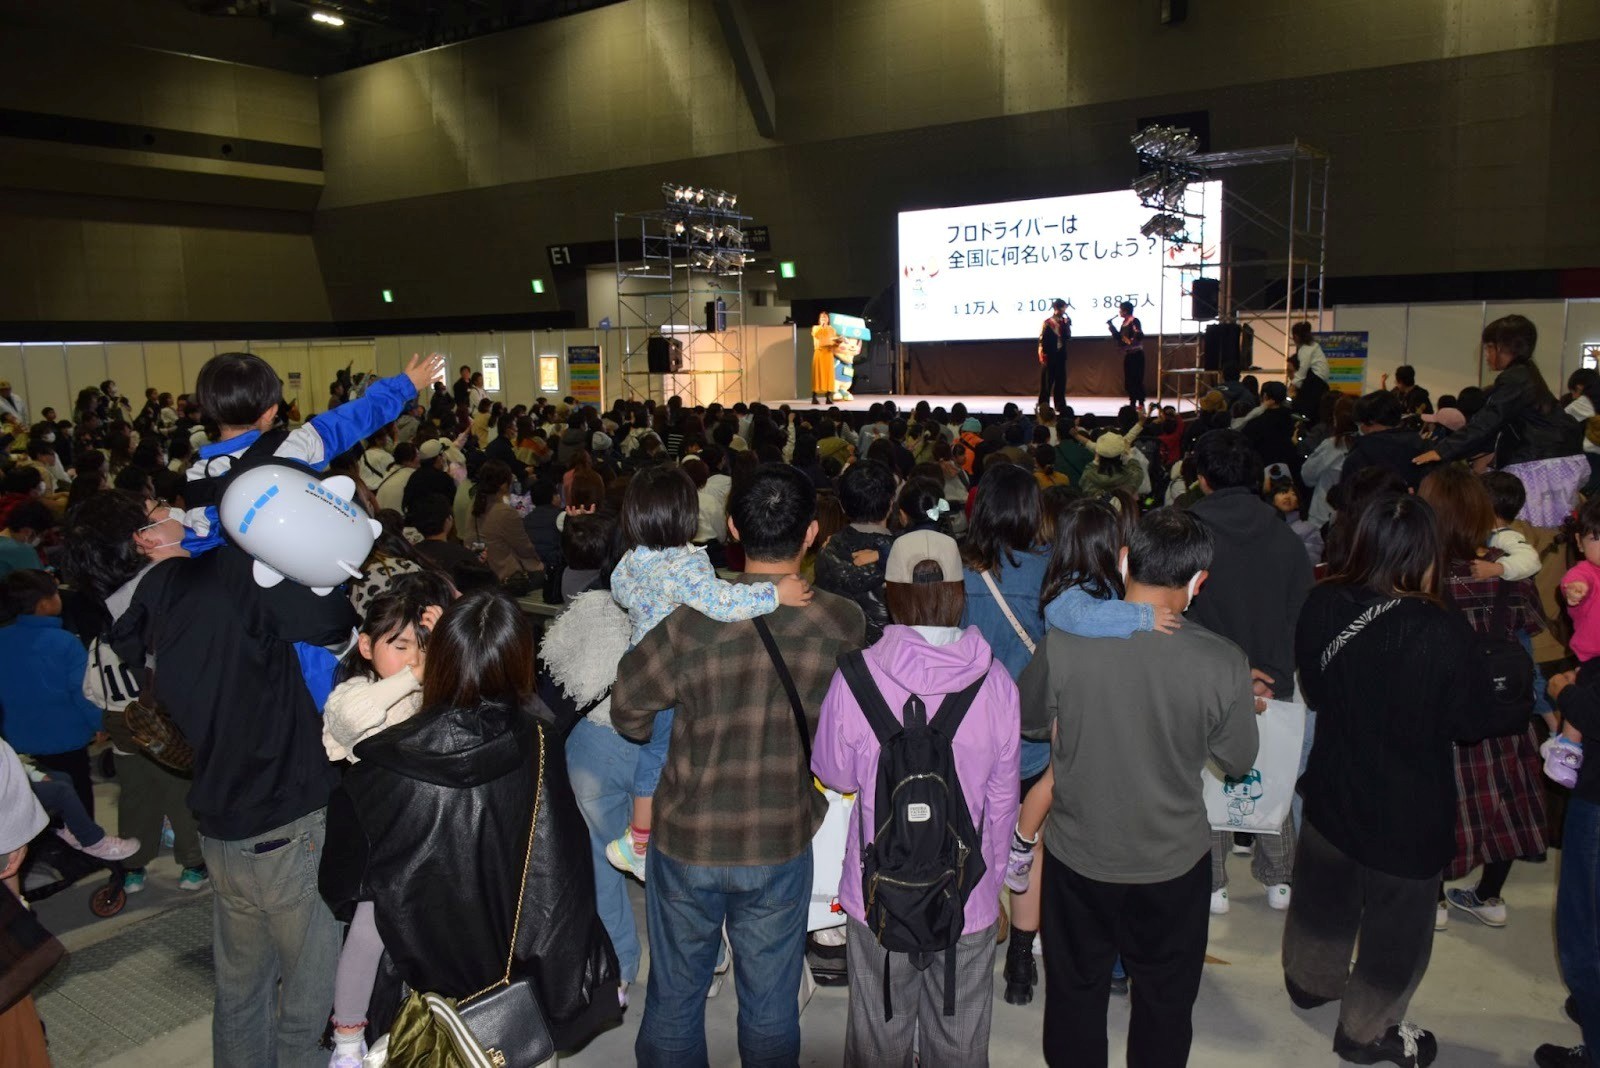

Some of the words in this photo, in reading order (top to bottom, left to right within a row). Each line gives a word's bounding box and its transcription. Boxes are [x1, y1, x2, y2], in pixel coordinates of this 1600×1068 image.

[947, 213, 1078, 244] プロドライバーは
[550, 246, 571, 265] E1
[964, 301, 999, 315] 1万人
[1017, 301, 1023, 312] 2
[1091, 298, 1098, 308] 3
